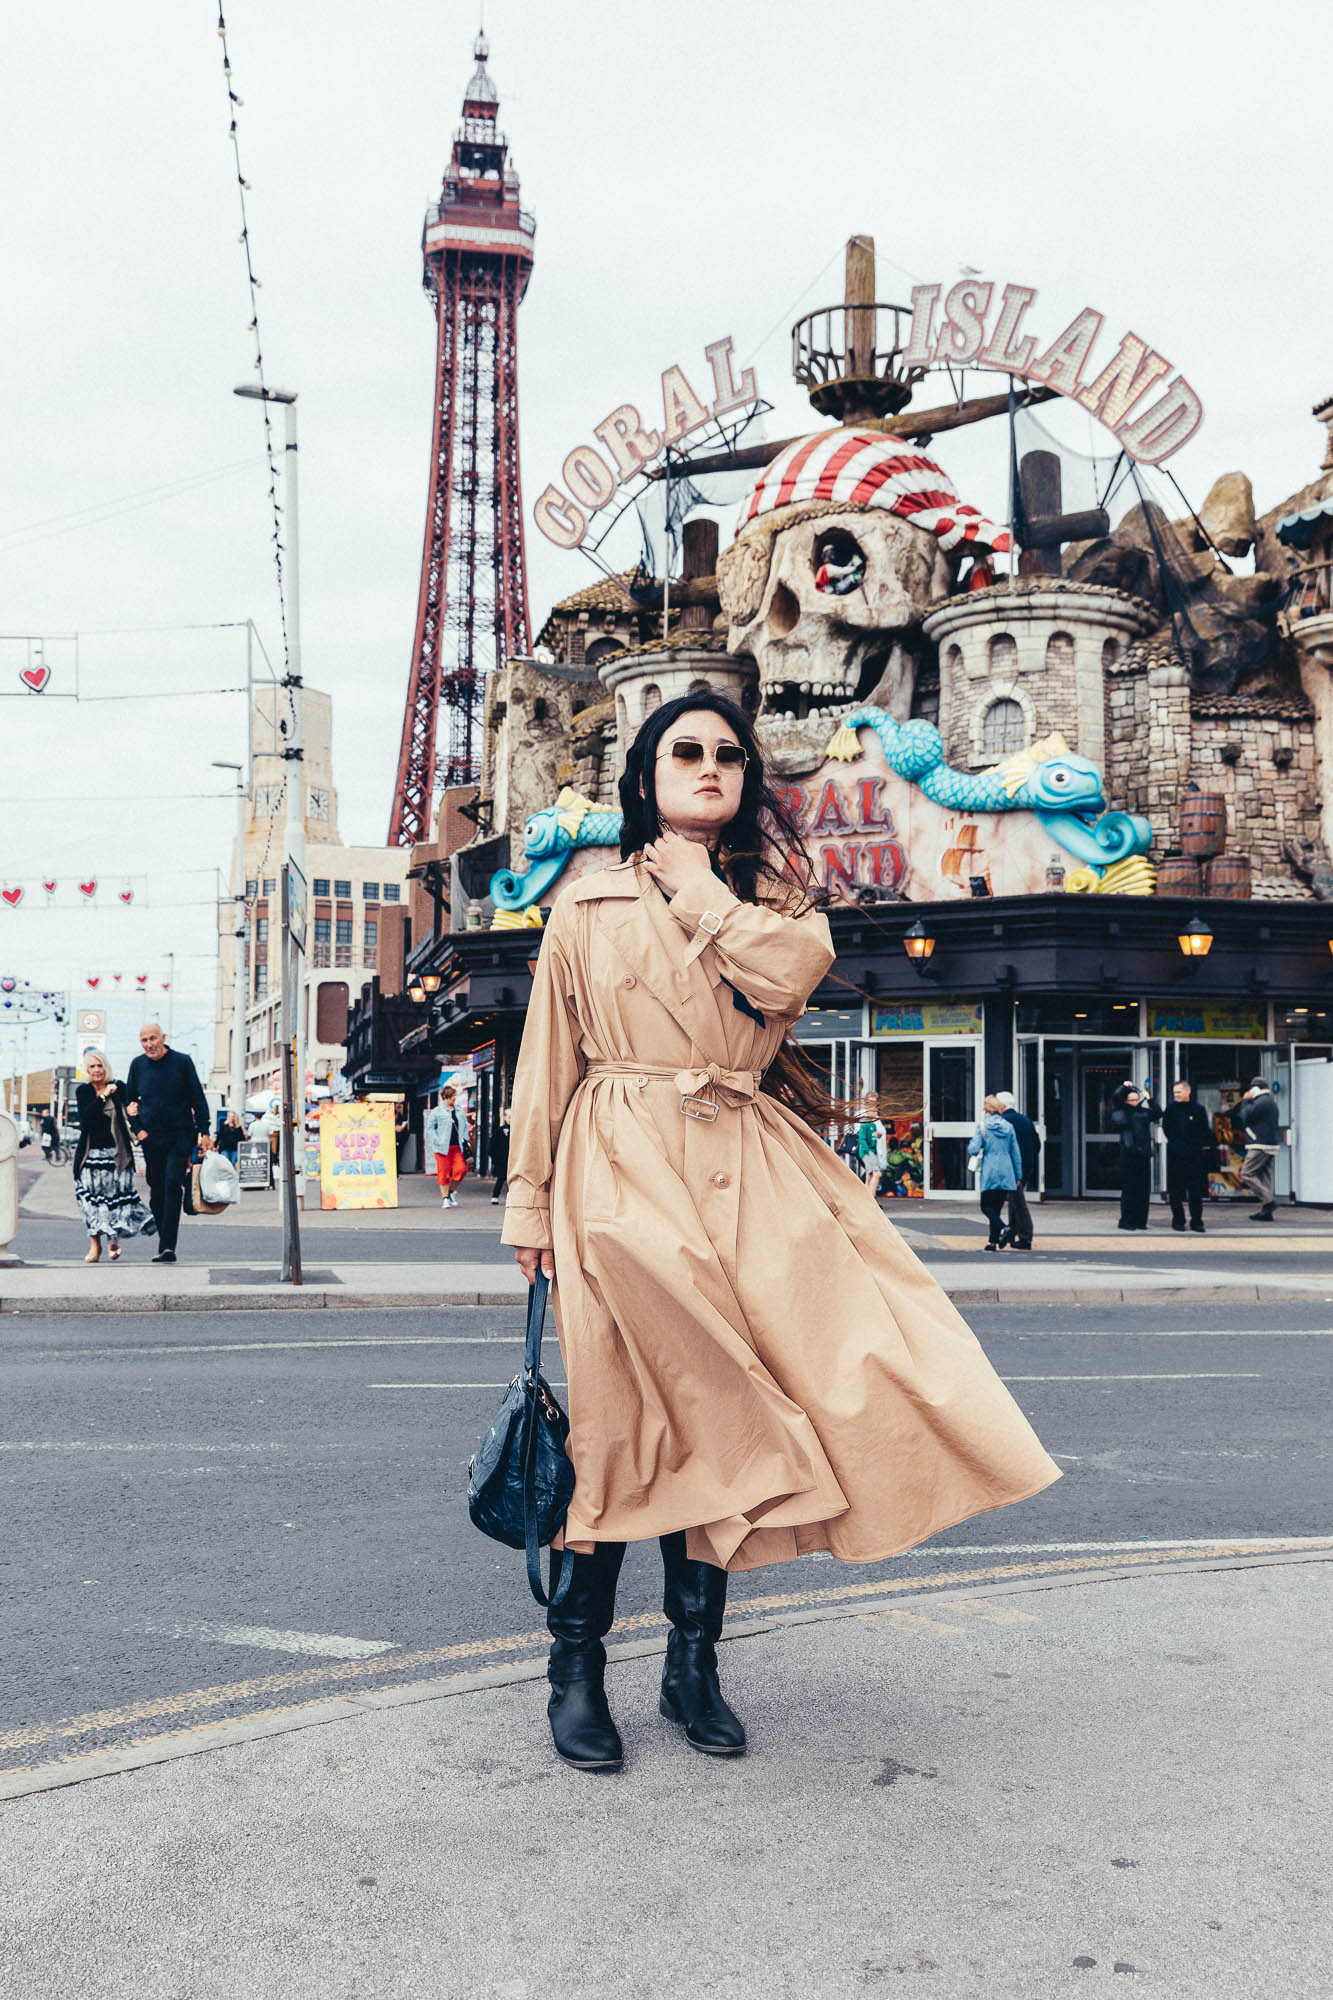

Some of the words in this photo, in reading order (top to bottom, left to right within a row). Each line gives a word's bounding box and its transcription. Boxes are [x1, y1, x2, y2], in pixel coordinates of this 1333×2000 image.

[534, 335, 759, 549] CORAL
[902, 279, 1203, 465] ISLAND
[760, 776, 895, 839] RAL
[335, 1133, 381, 1148] KIDS
[340, 1147, 376, 1161] EAT
[241, 1159, 267, 1168] STOP
[332, 1160, 387, 1176] FREE
